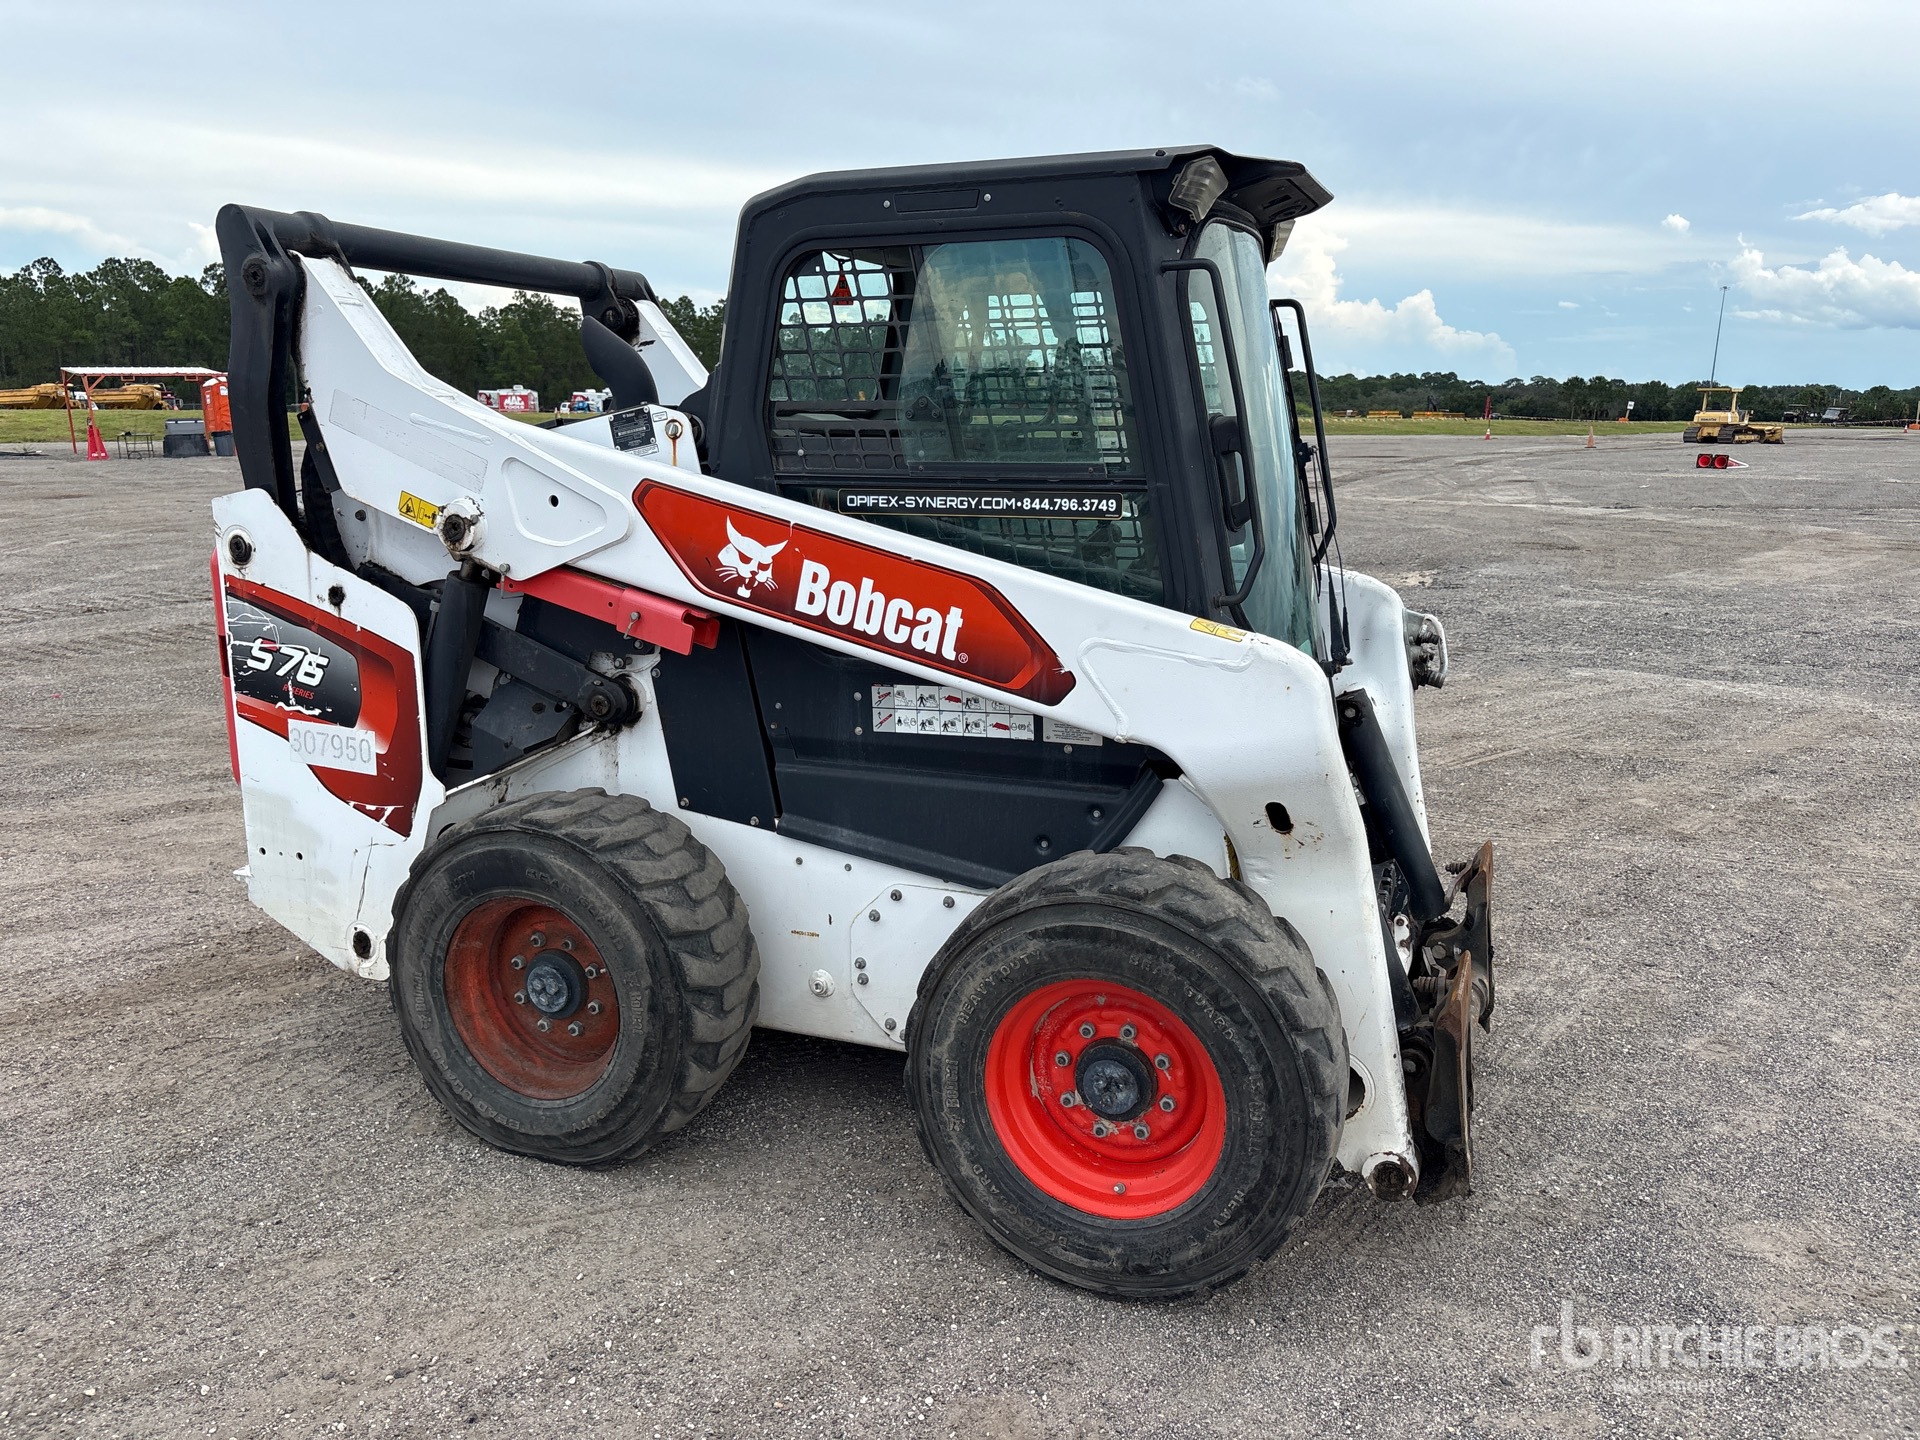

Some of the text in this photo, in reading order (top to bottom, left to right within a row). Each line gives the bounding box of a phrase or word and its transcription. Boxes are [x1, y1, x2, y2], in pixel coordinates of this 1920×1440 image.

[795, 559, 963, 661] Bobcat
[247, 637, 330, 687] S76
[290, 727, 372, 764] 307950
